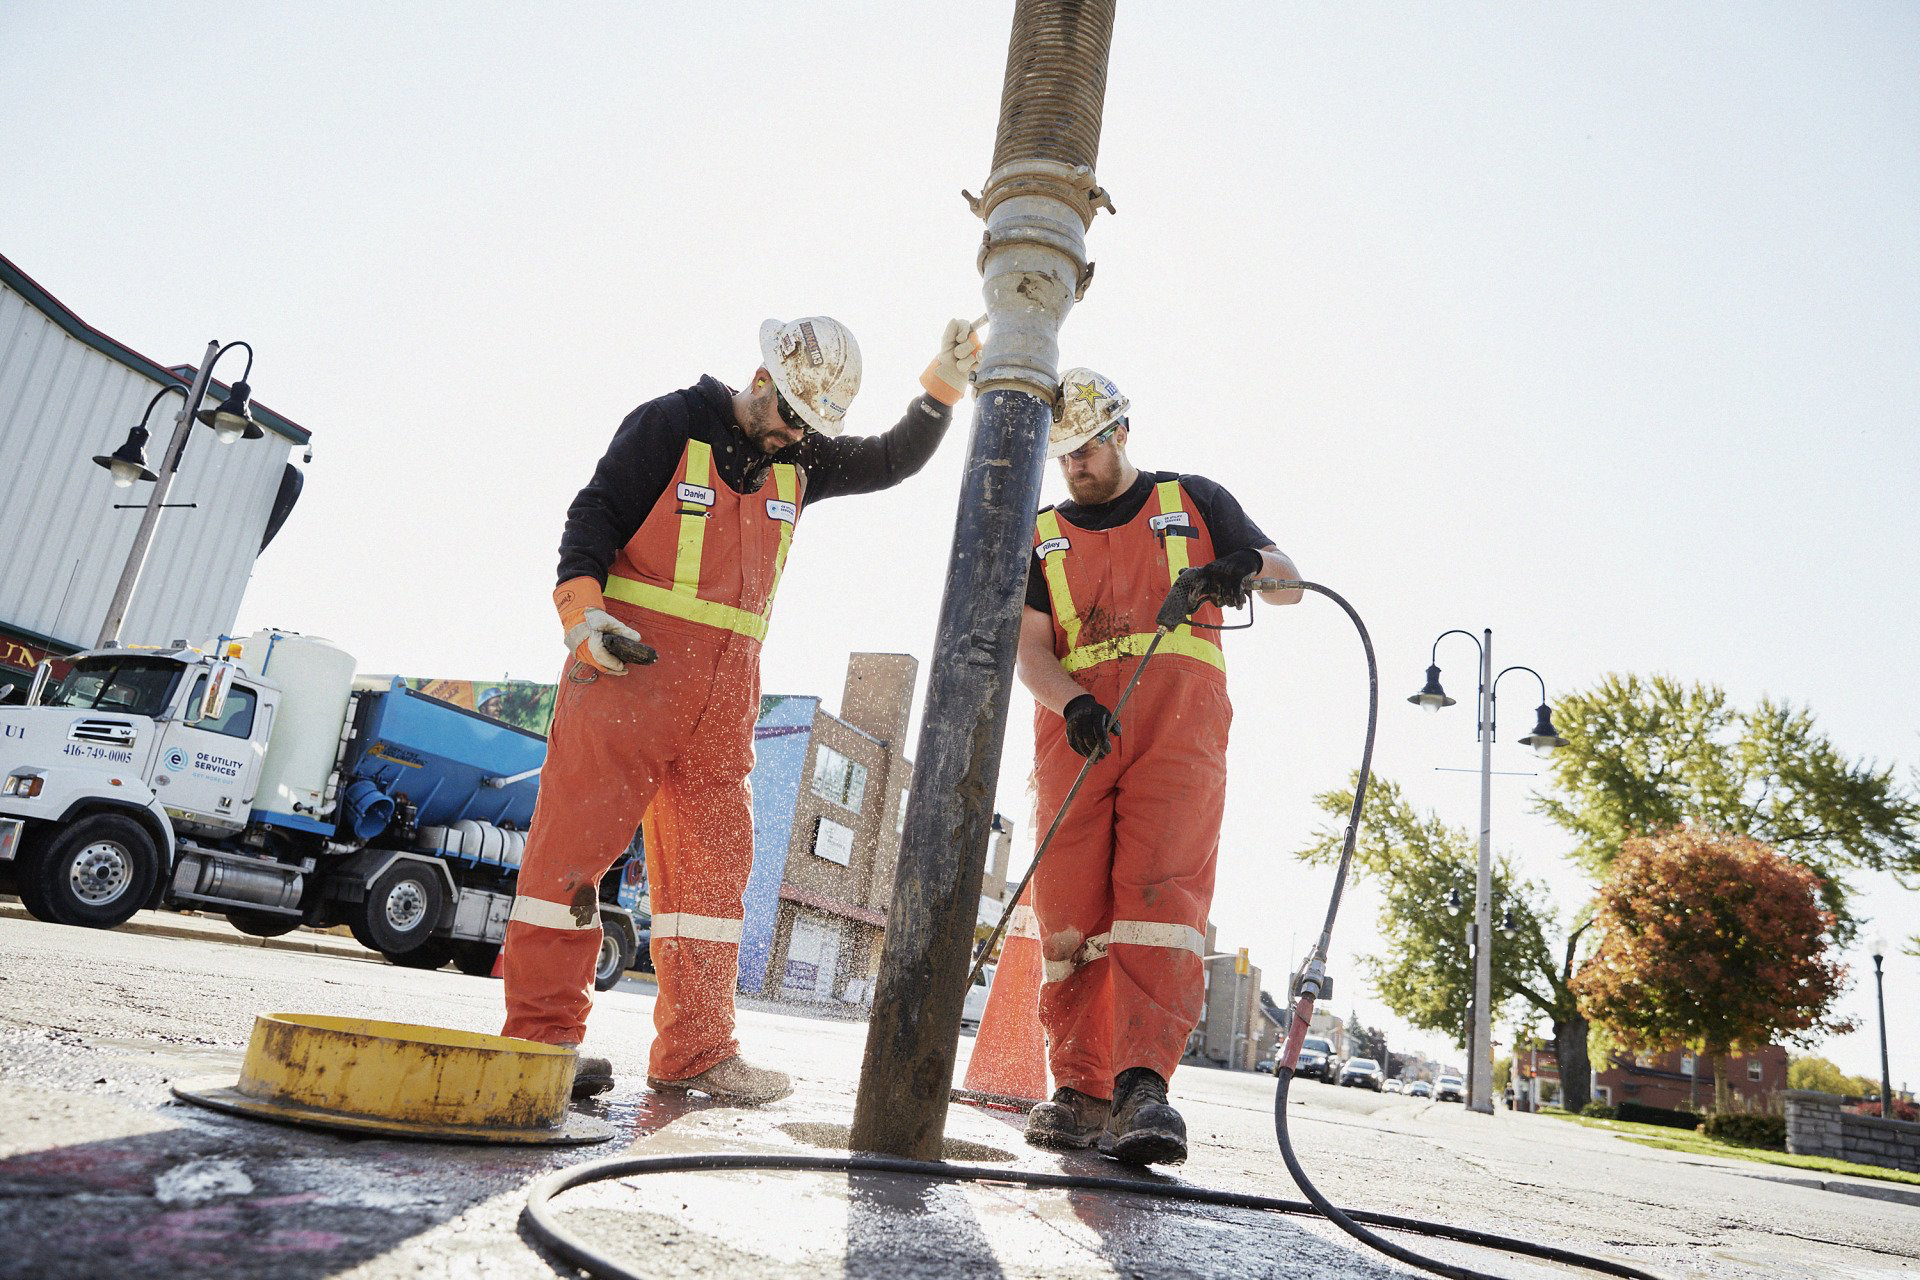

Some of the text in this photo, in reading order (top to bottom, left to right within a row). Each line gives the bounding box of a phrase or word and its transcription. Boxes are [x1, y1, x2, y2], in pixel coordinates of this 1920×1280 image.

[684, 488, 706, 500] Daniel
[63, 743, 132, 763] 416-749-0005
[196, 752, 243, 769] OE UTILITY
[194, 761, 236, 777] SERVICES
